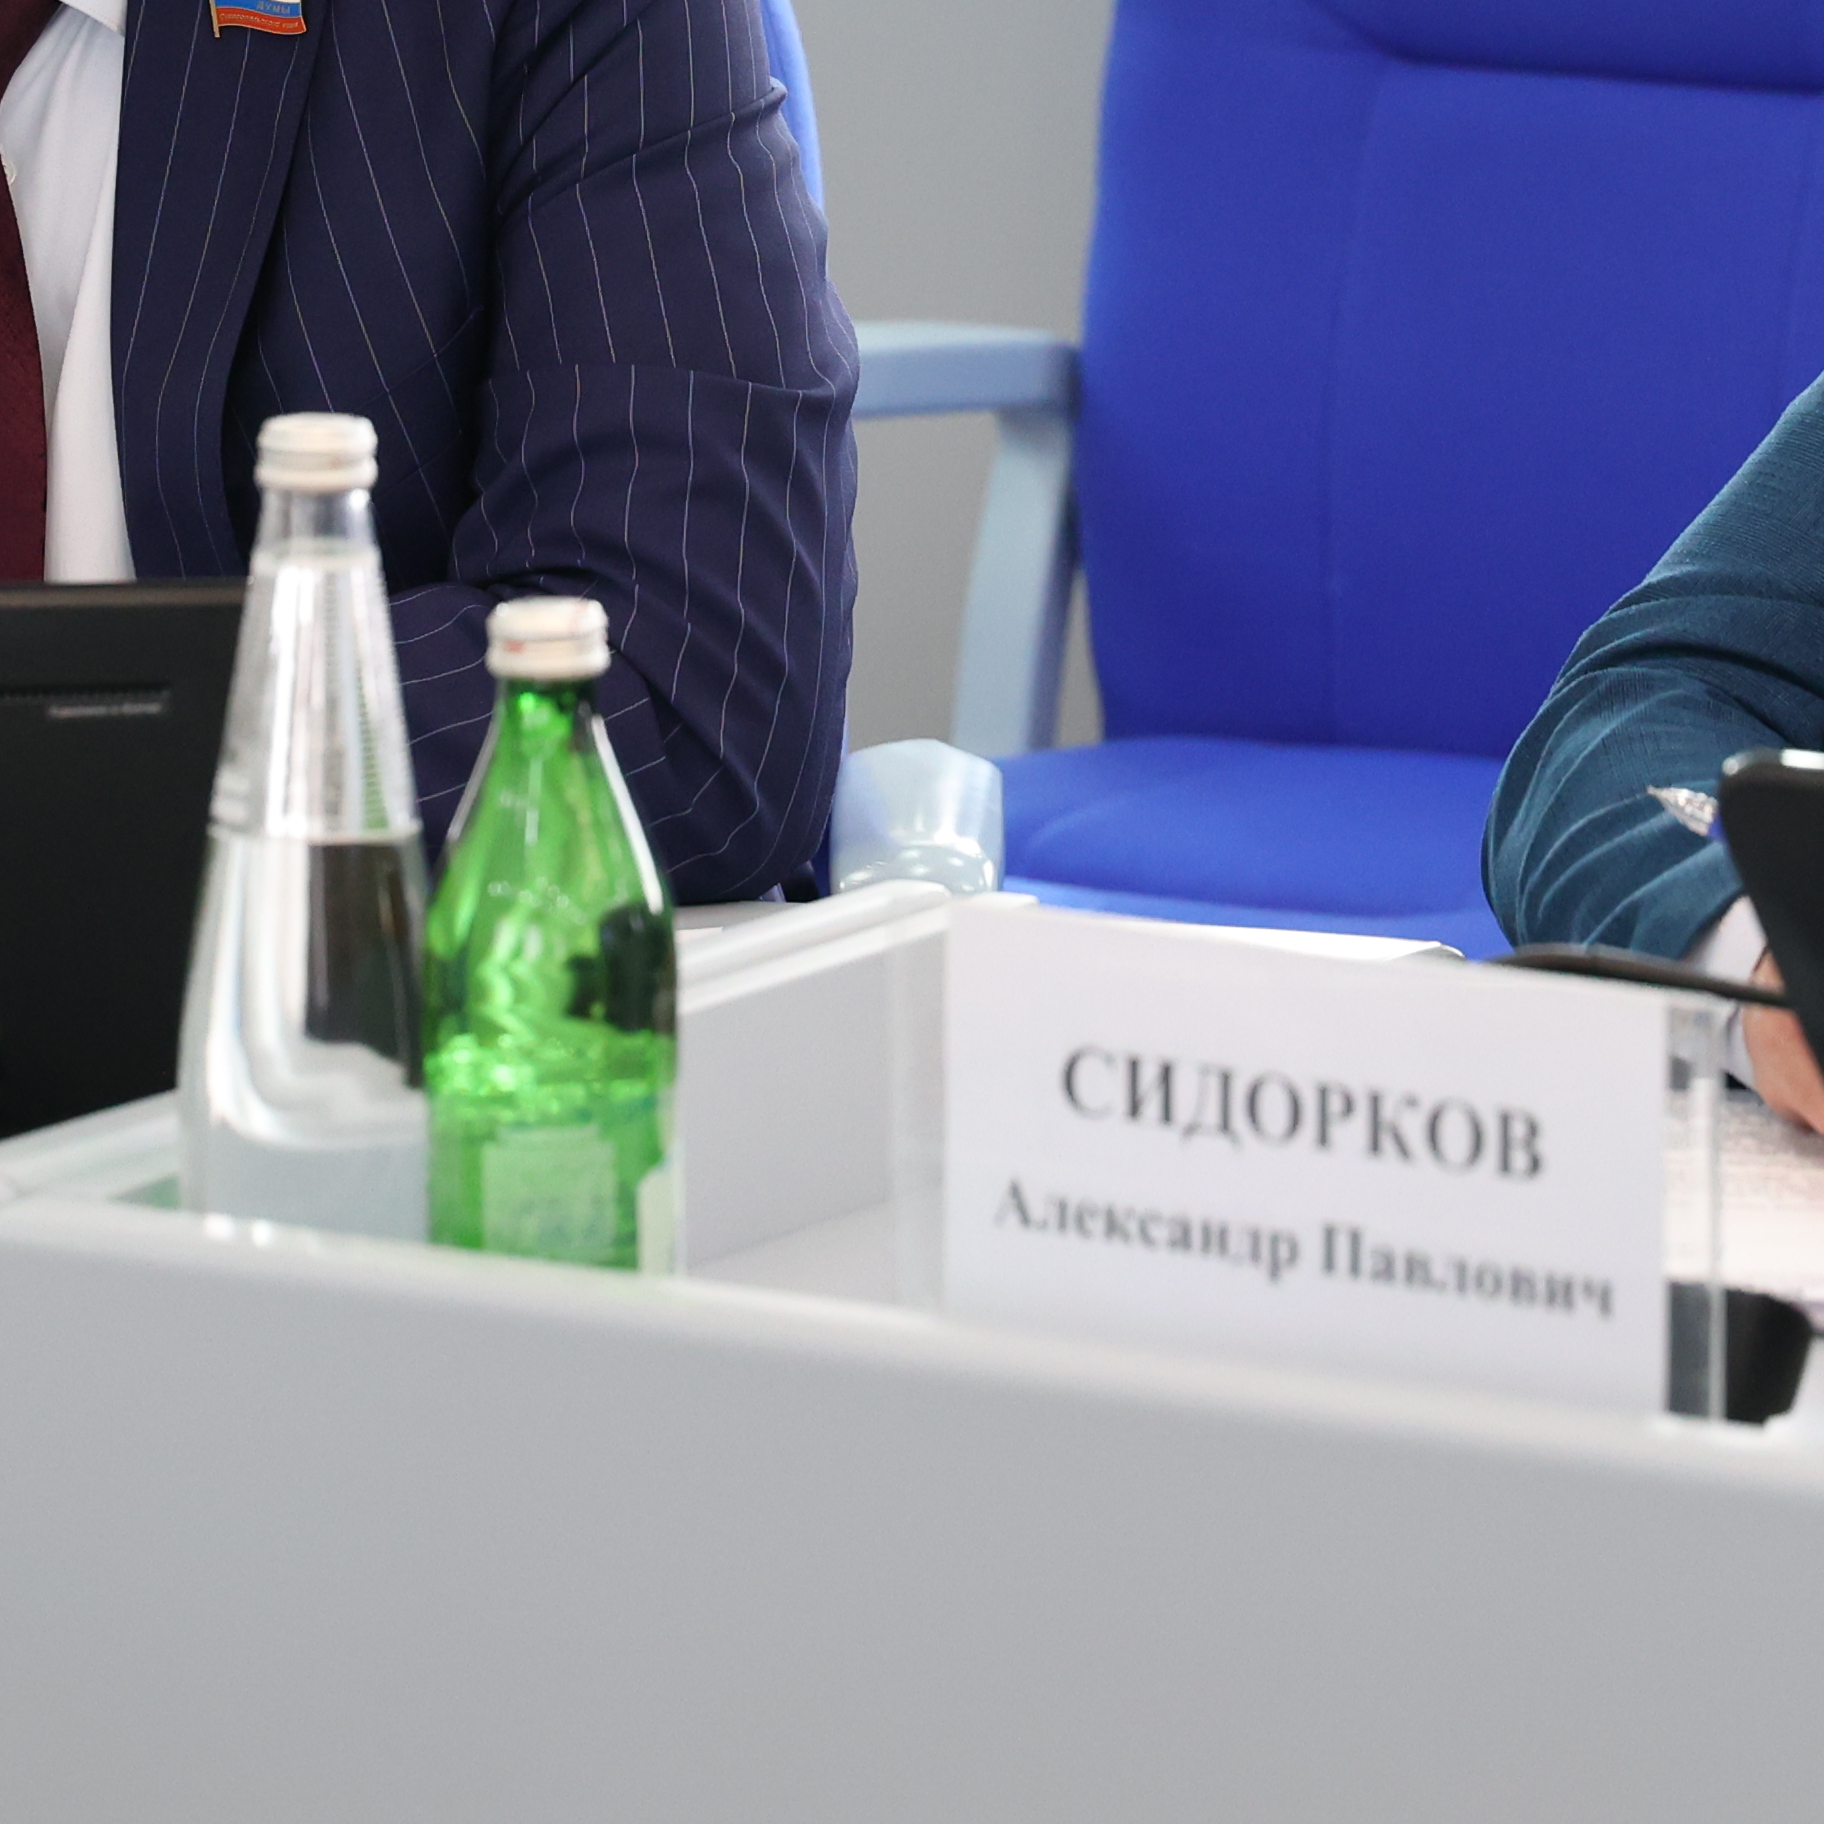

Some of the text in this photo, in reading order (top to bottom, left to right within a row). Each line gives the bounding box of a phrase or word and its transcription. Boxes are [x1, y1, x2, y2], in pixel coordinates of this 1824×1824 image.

[256, 0, 291, 14] ДУМЫ
[1060, 1043, 1546, 1181] СИДОРКОВ
[994, 1176, 1614, 1319] Александр Павлович
